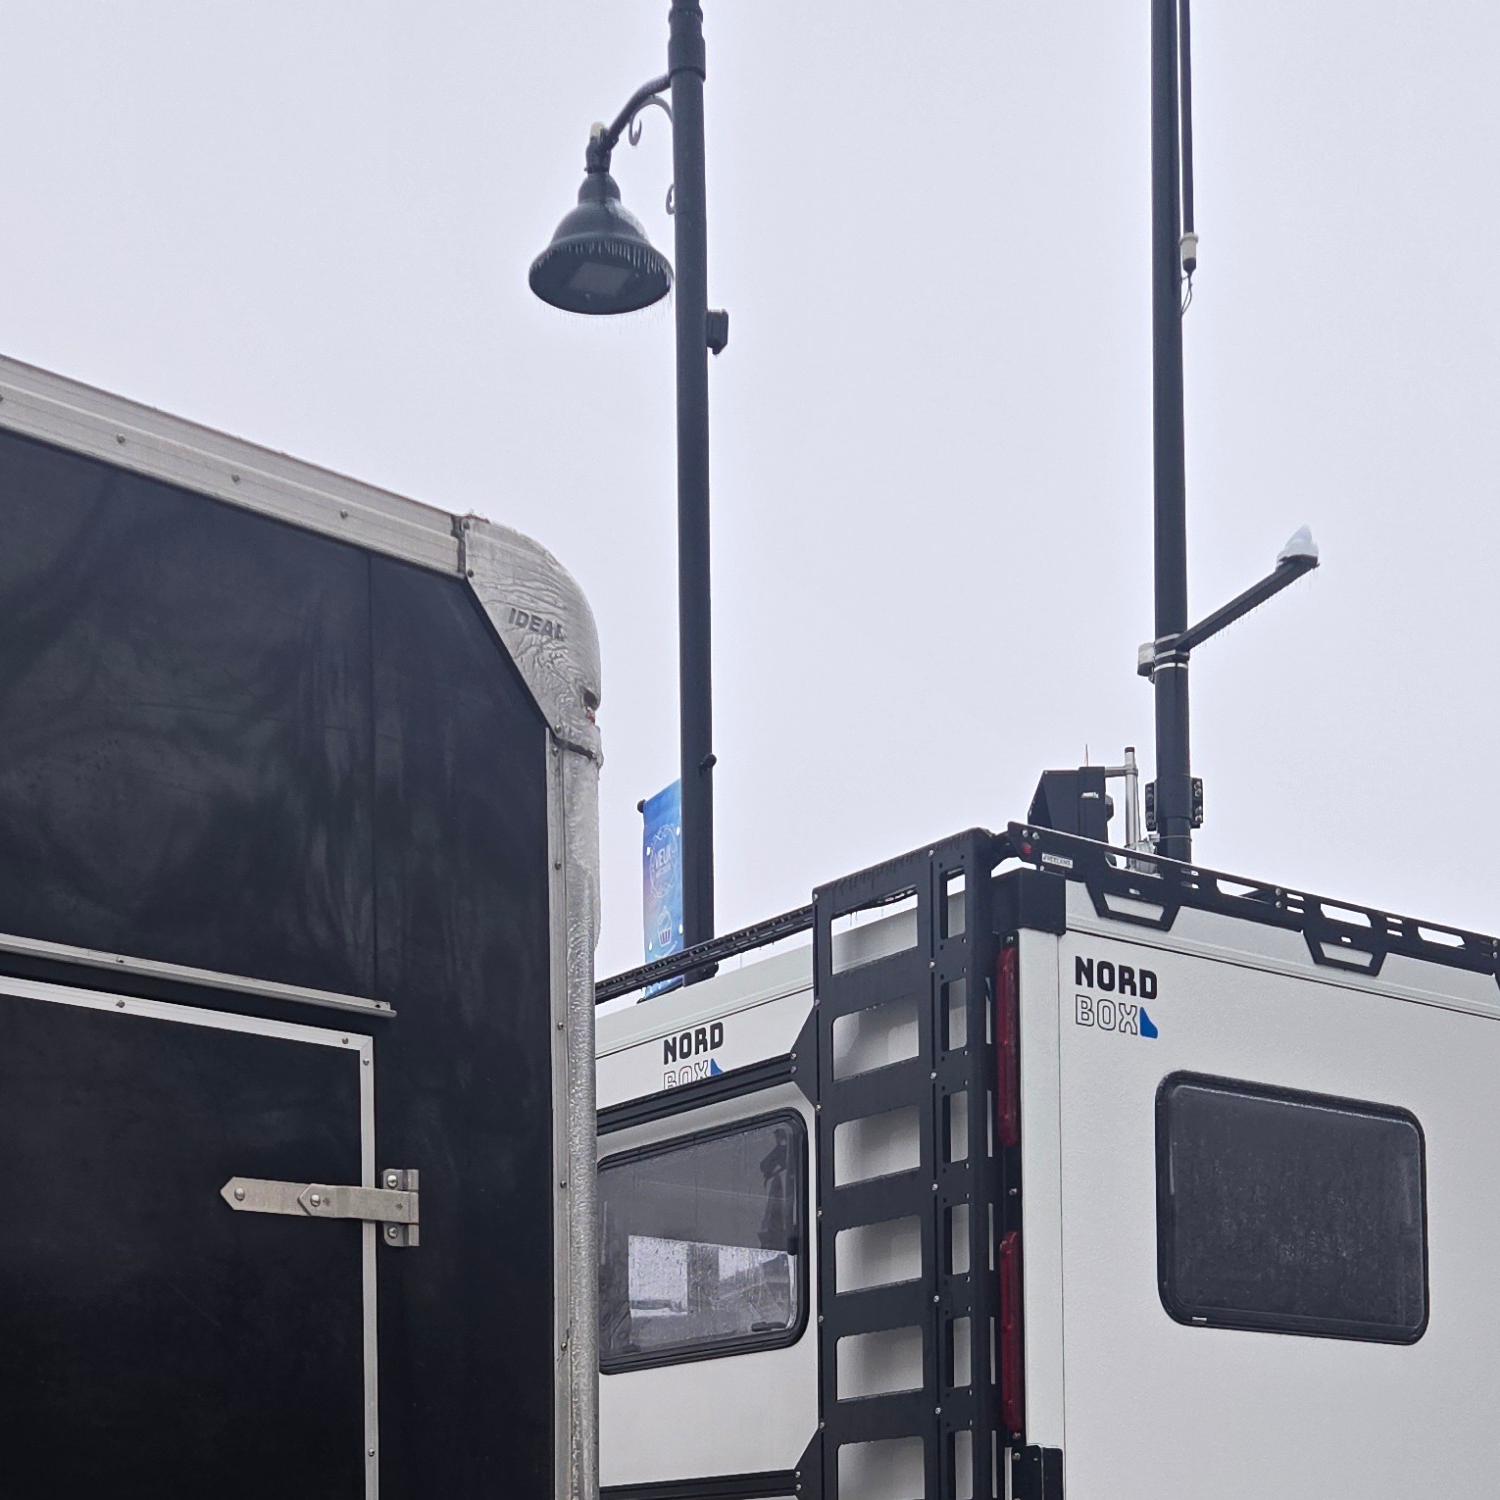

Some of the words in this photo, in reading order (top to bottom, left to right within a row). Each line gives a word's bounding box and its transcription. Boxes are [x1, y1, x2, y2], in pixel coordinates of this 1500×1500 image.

[507, 606, 566, 642] IDEAL
[1075, 955, 1158, 1000] NORD
[1075, 993, 1138, 1036] BOX
[663, 1021, 724, 1066] NORD
